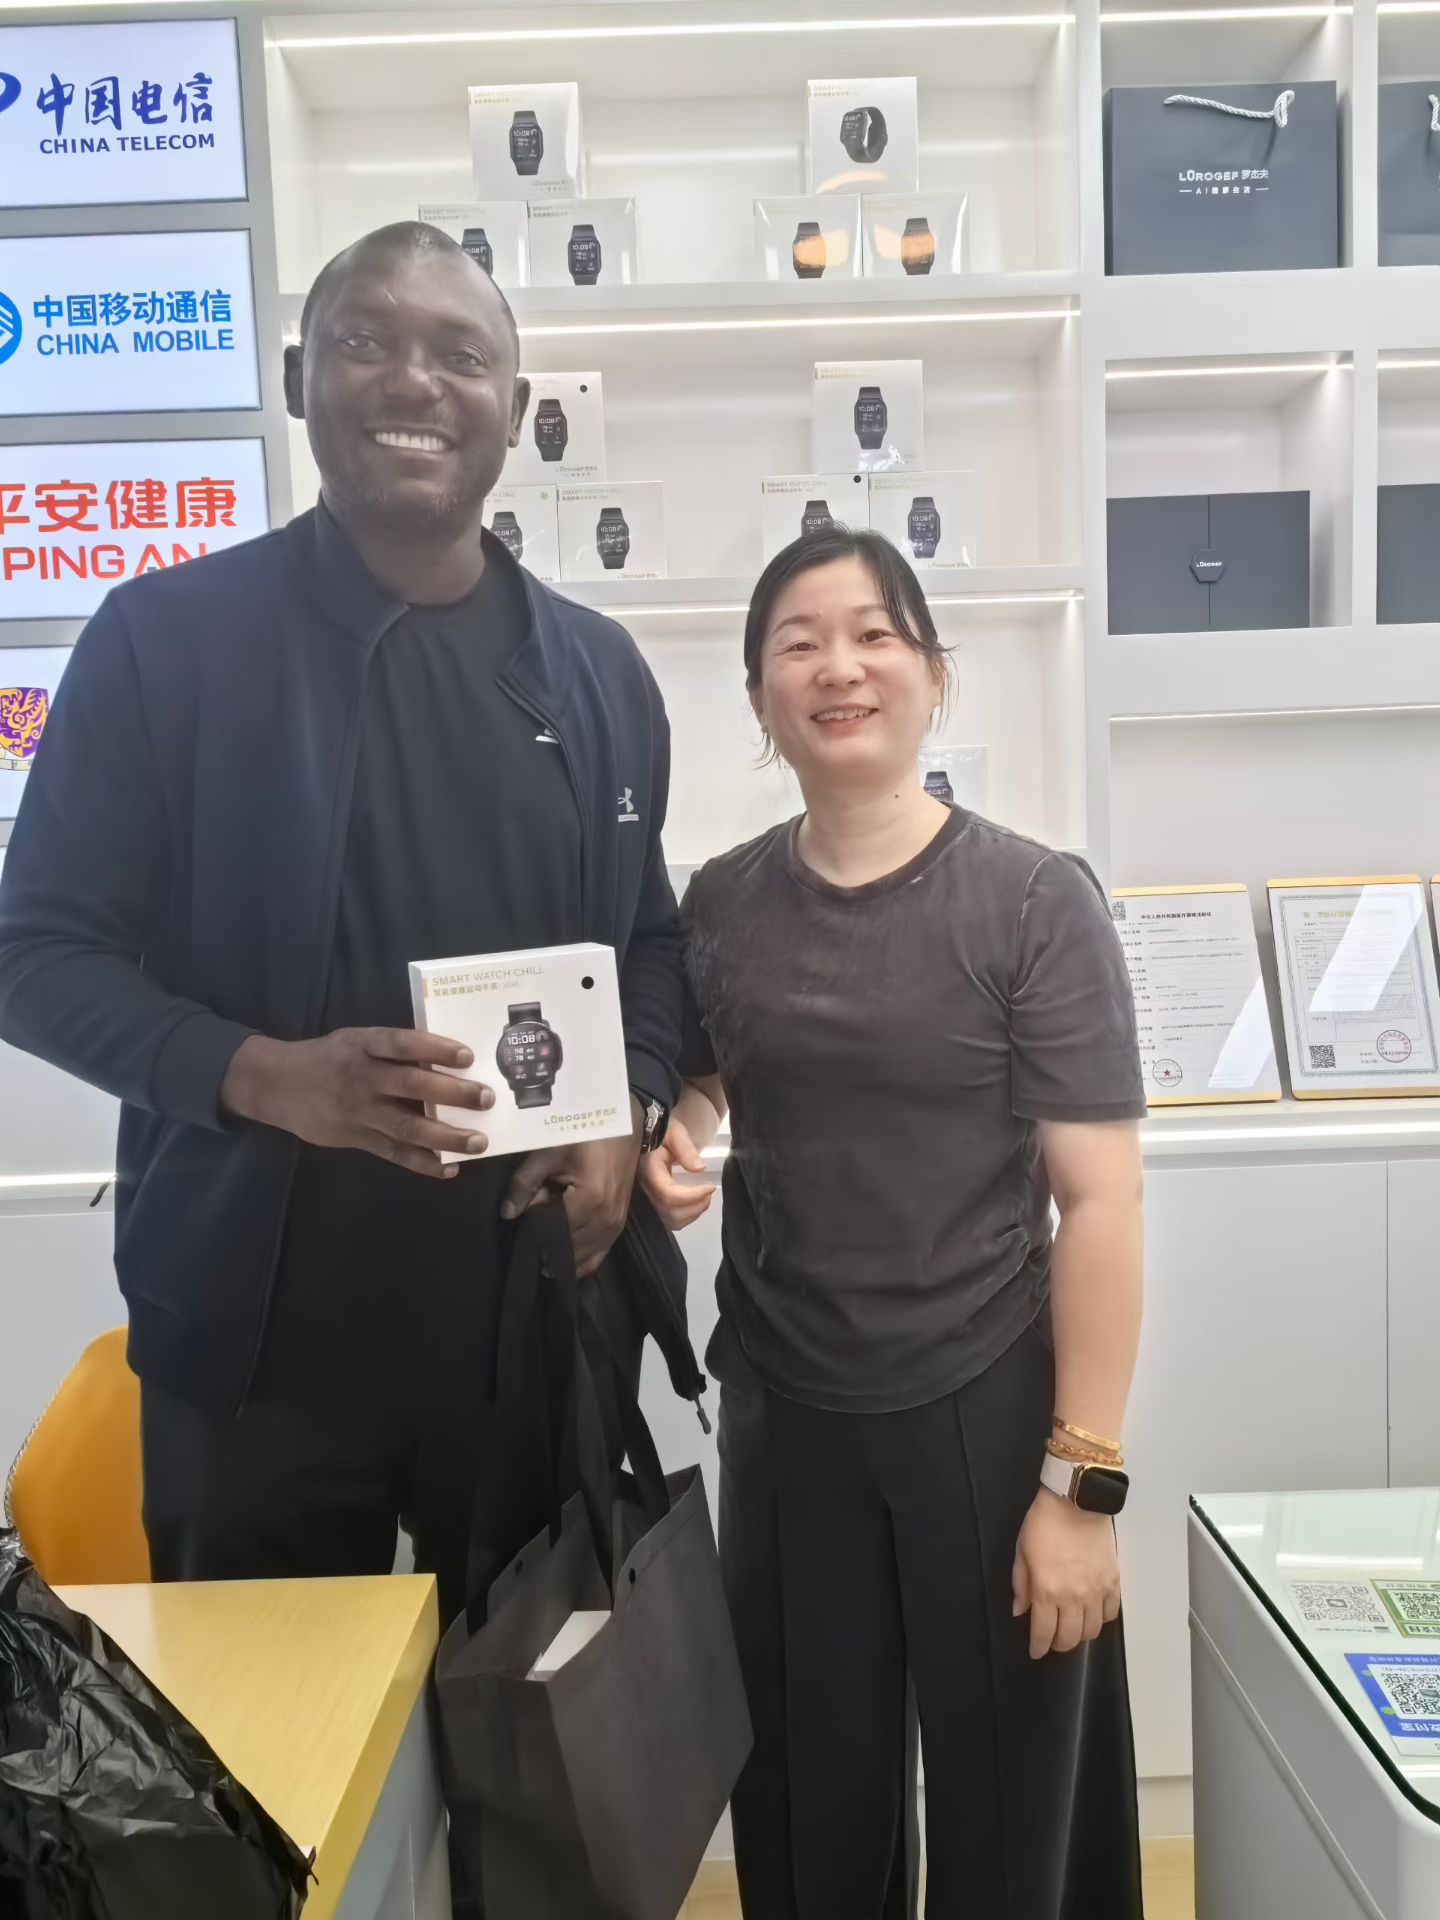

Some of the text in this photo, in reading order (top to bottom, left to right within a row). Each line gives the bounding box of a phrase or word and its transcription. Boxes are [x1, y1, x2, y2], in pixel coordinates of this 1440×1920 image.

[36, 72, 213, 137] 中国电信
[39, 132, 215, 154] CHINA TELECOM
[33, 288, 232, 328] 中国移动通信
[36, 328, 235, 356] CHINA MOBILE
[432, 965, 545, 986] SMART WATCH CHILL
[507, 1034, 536, 1046] 10:08
